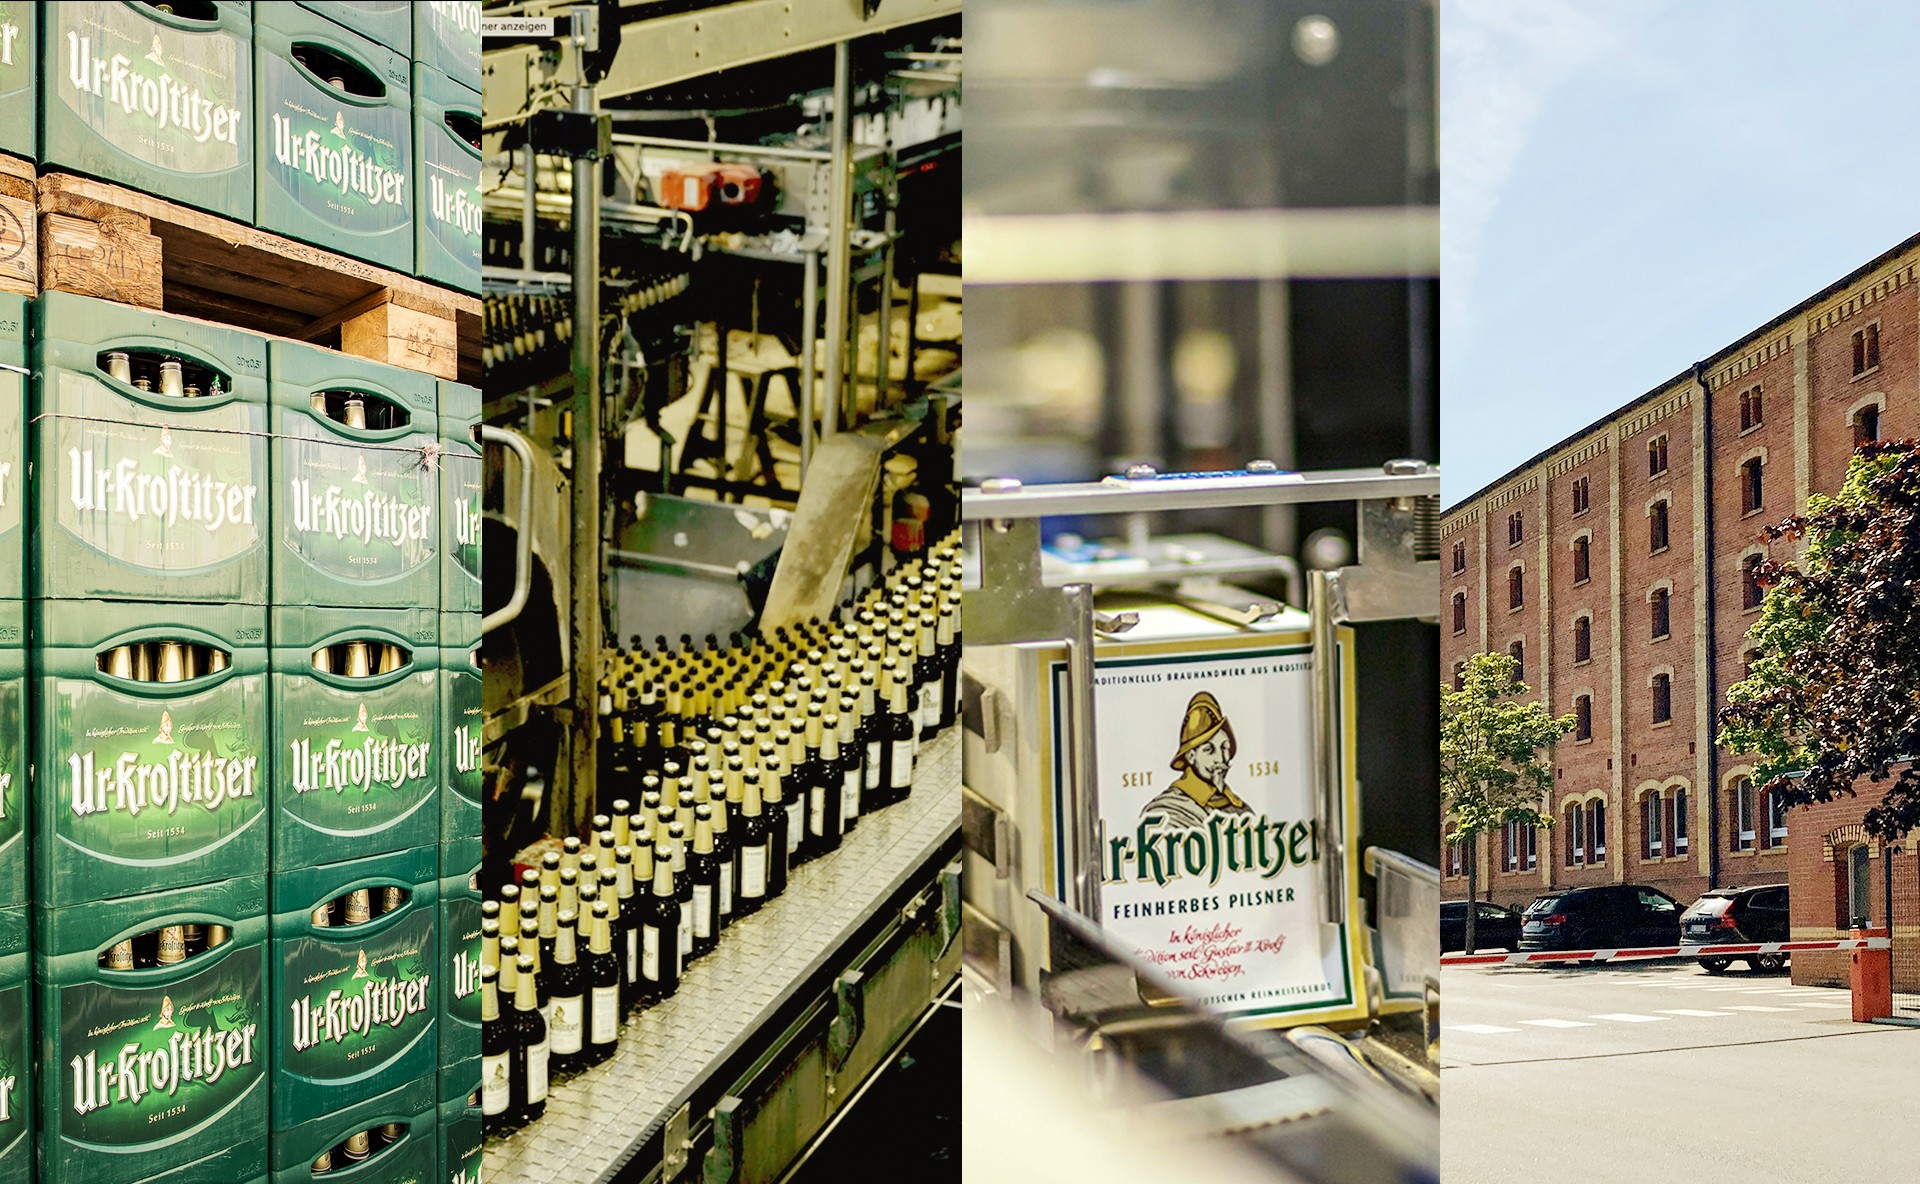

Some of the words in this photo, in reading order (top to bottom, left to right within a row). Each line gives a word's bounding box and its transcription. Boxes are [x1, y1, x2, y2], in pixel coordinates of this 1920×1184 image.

[139, 134, 154, 149] Seit
[155, 141, 175, 154] 1534
[327, 200, 340, 213] Seit
[340, 203, 355, 216] 1534
[146, 541, 163, 551] Seit
[165, 542, 185, 551] 1534
[348, 555, 361, 565] Seit
[362, 556, 378, 565] 1534
[1095, 673, 1162, 686] ADITIONELLES
[1167, 667, 1246, 681] BRAUHANDWERK
[1251, 666, 1268, 675] AUS
[1122, 771, 1152, 788] SEIT
[1248, 761, 1279, 777] 1534
[347, 805, 360, 815] Seit
[361, 803, 377, 813] 1534
[147, 829, 164, 840] Seit
[165, 826, 186, 837] 1534
[1113, 897, 1219, 920] FEINHERBES
[1229, 888, 1295, 909] PILSNER
[1169, 930, 1181, 943] In
[1183, 922, 1243, 944] königlicher
[1179, 944, 1203, 961] seit
[1251, 982, 1332, 999] REINHEITSGEBOT
[347, 1052, 361, 1061] Seit
[361, 1045, 377, 1057] 1534
[148, 1112, 165, 1124] Seit
[166, 1104, 187, 1118] 1534
